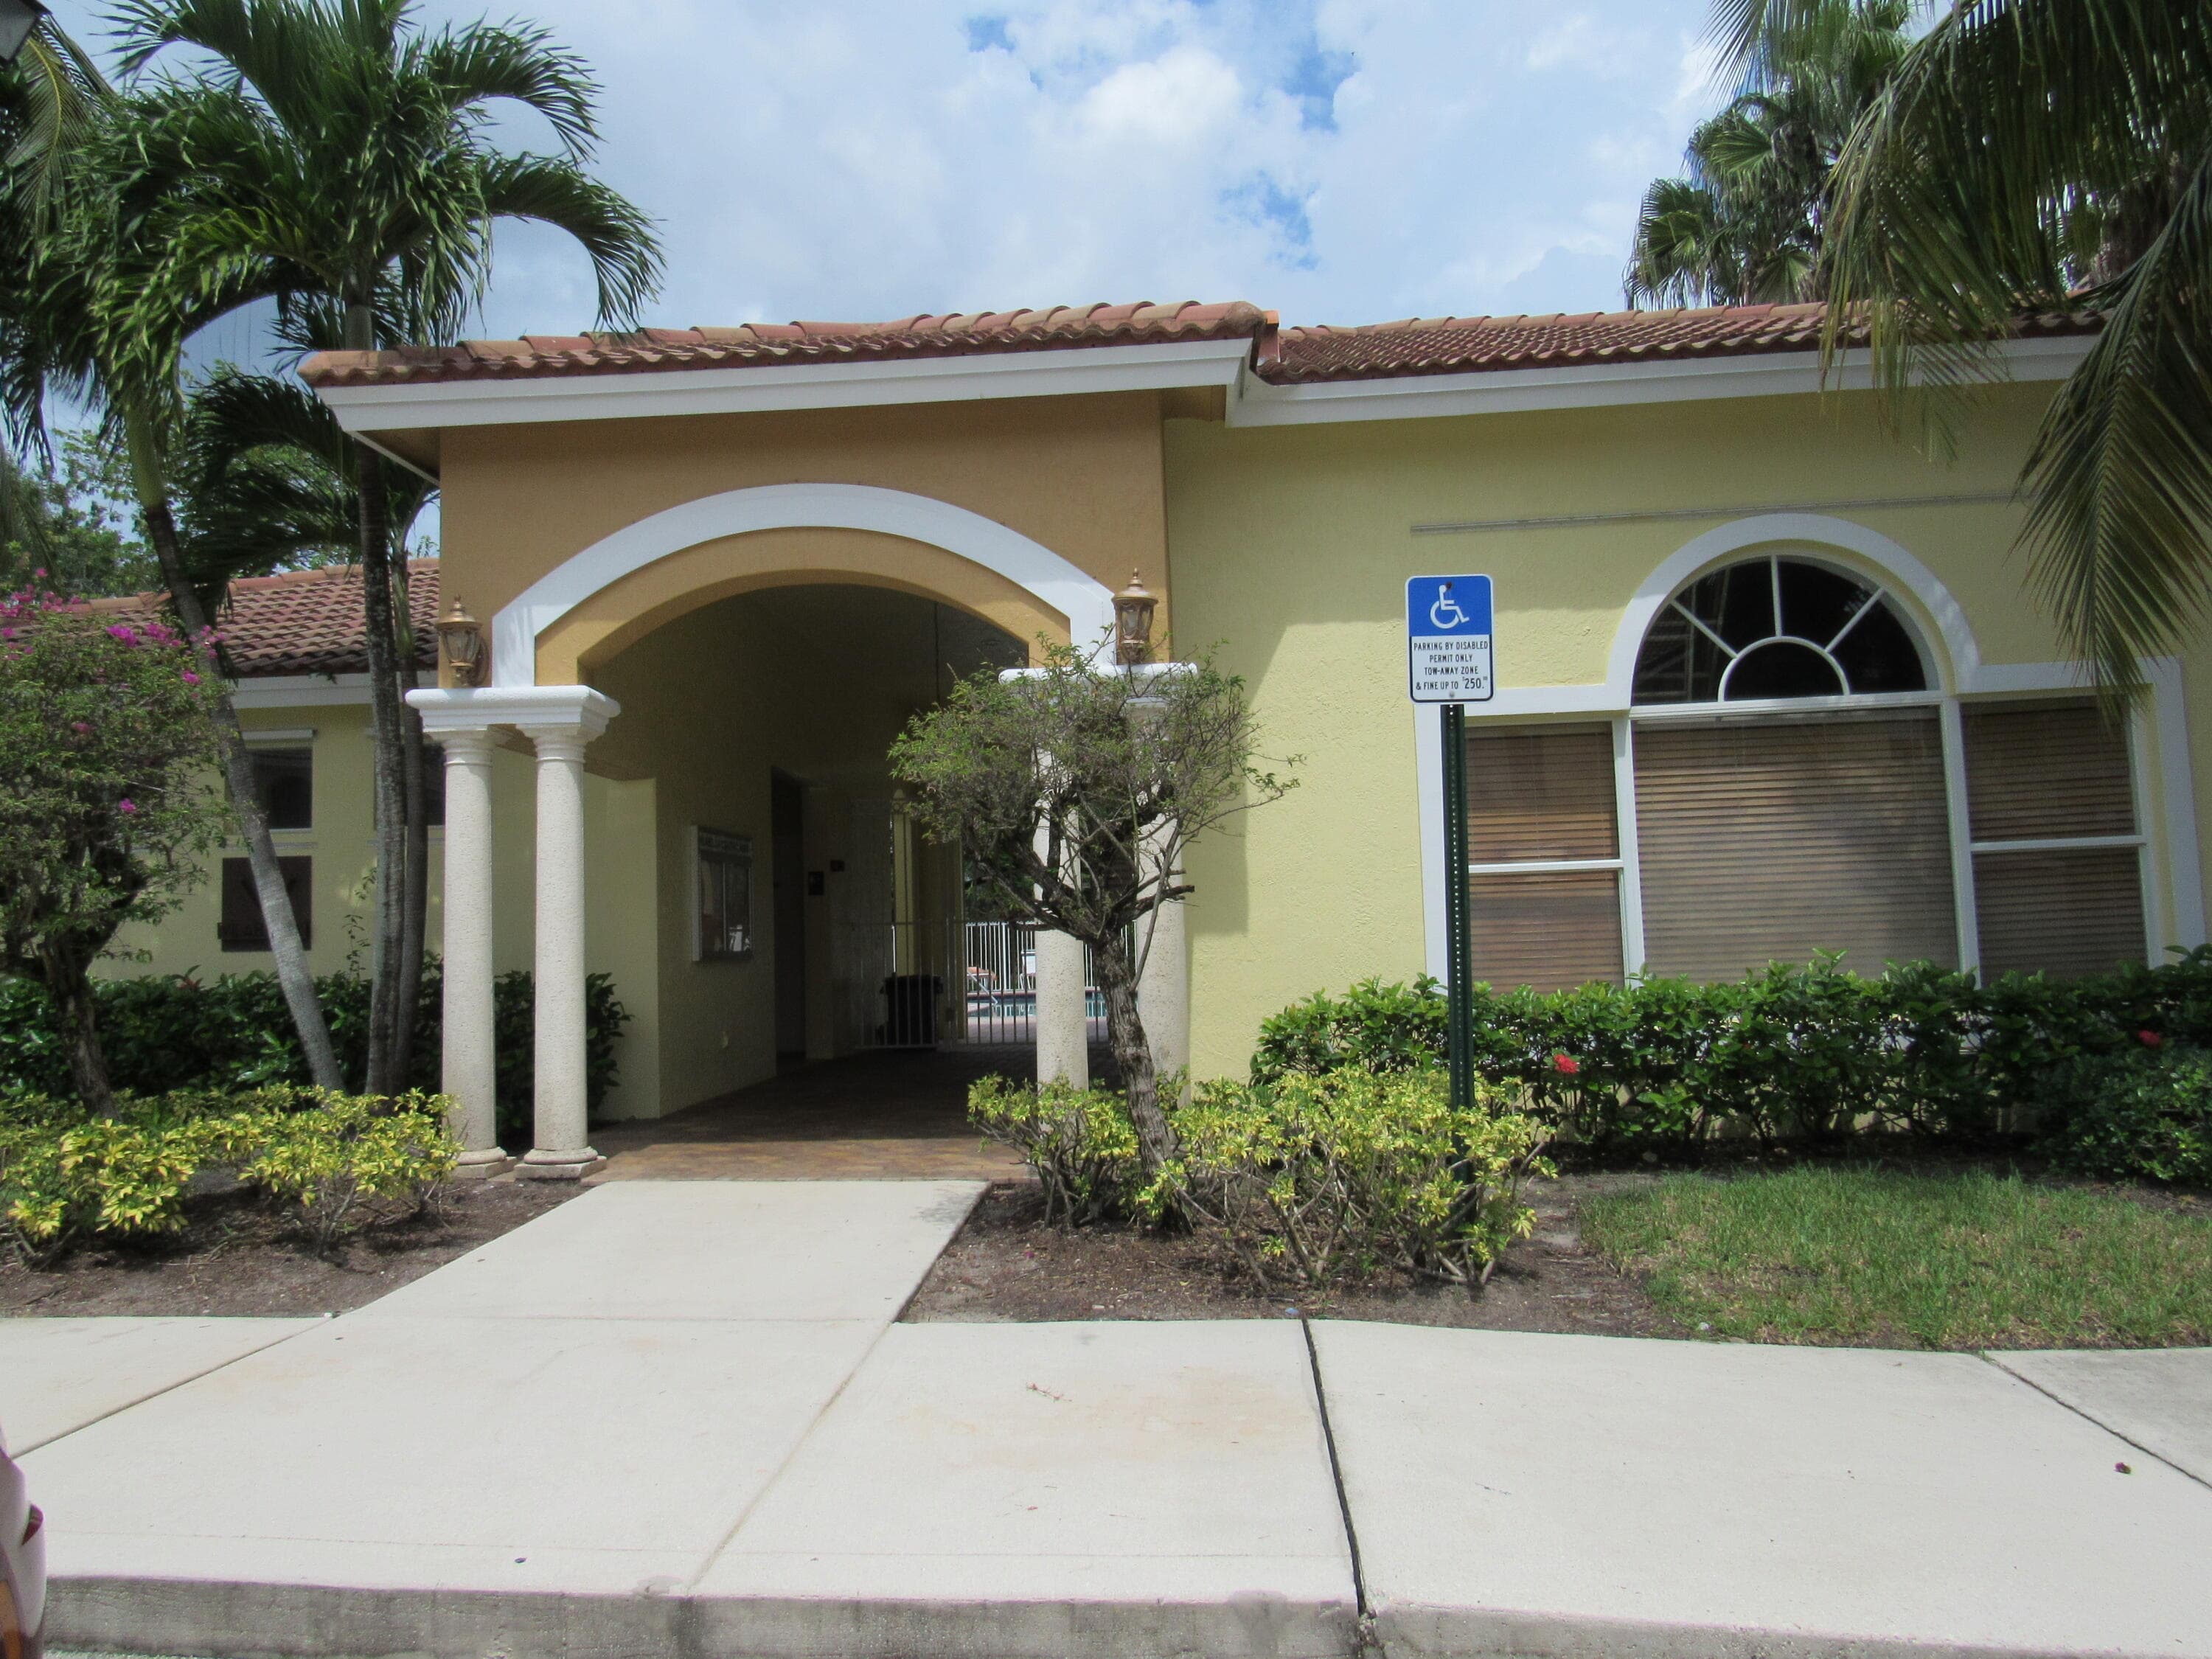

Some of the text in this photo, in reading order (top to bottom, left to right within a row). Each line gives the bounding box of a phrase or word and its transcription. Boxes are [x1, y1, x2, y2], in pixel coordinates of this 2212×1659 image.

[1413, 641, 1488, 651] PARKING BY DISABLED
[1429, 654, 1473, 664] PERMIT ONLY
[1425, 666, 1478, 675] TOW-AWAY ZONE
[1416, 682, 1422, 690] &
[1423, 681, 1438, 690] FINE
[1440, 681, 1450, 690] UP
[1450, 681, 1458, 689] TO
